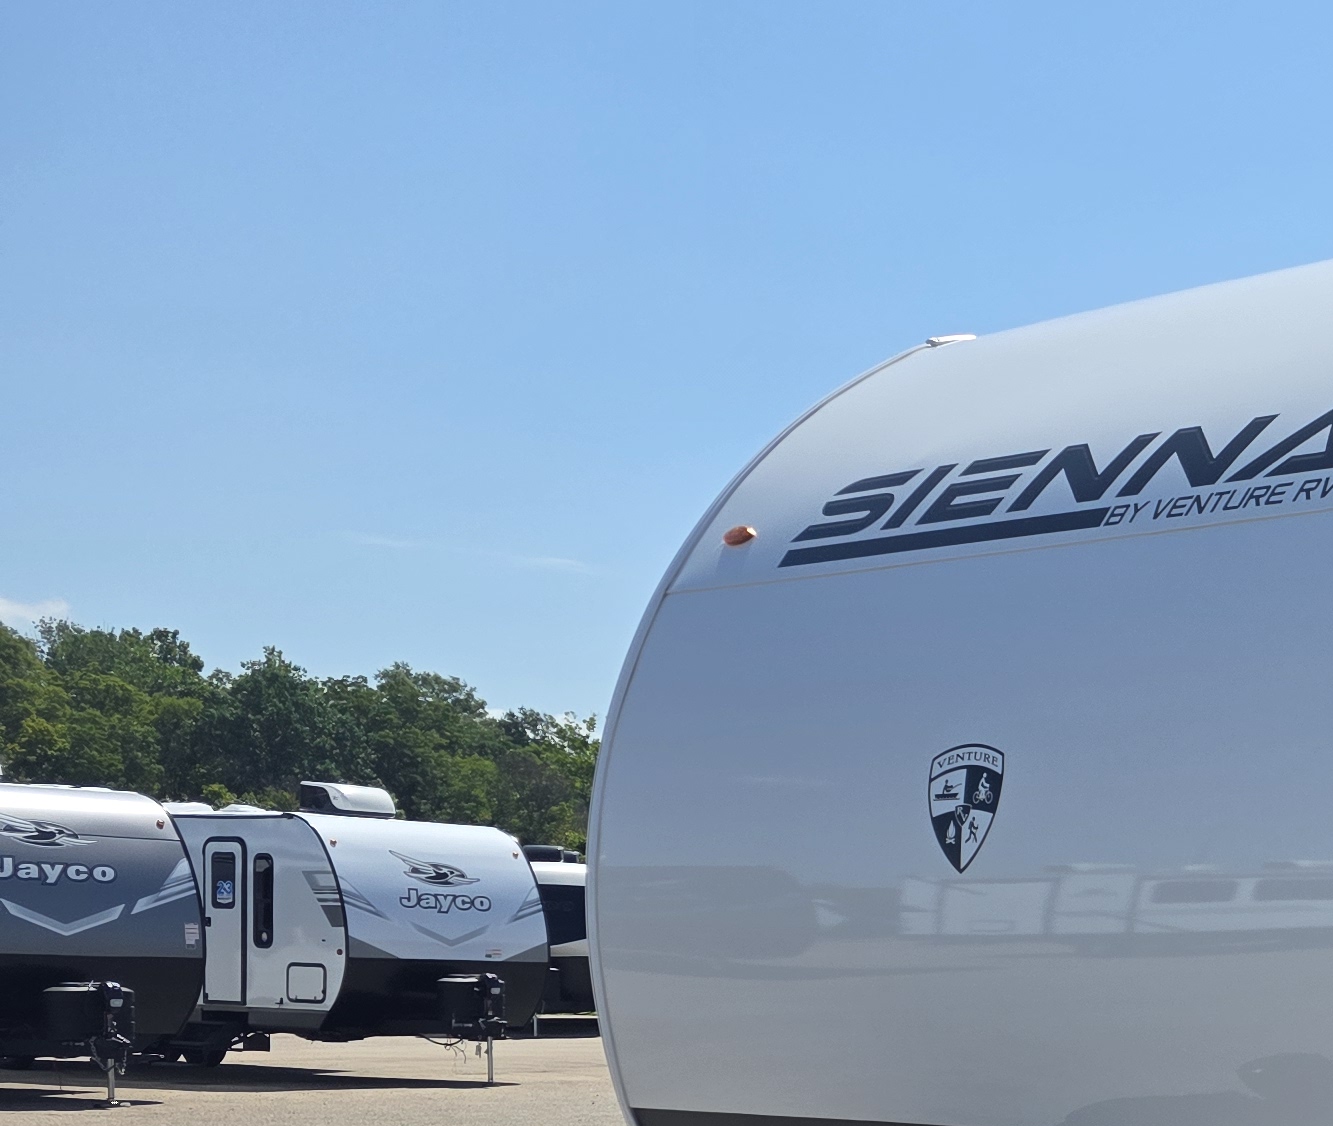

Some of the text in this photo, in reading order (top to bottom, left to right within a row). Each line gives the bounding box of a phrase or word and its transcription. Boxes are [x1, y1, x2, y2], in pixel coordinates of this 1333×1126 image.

[1103, 500, 1151, 527] BY
[1152, 481, 1294, 520] VENTURE
[936, 750, 999, 769] VENTURE
[956, 806, 969, 822] RV
[0, 855, 117, 886] Jayco
[400, 887, 492, 914] Jayco
